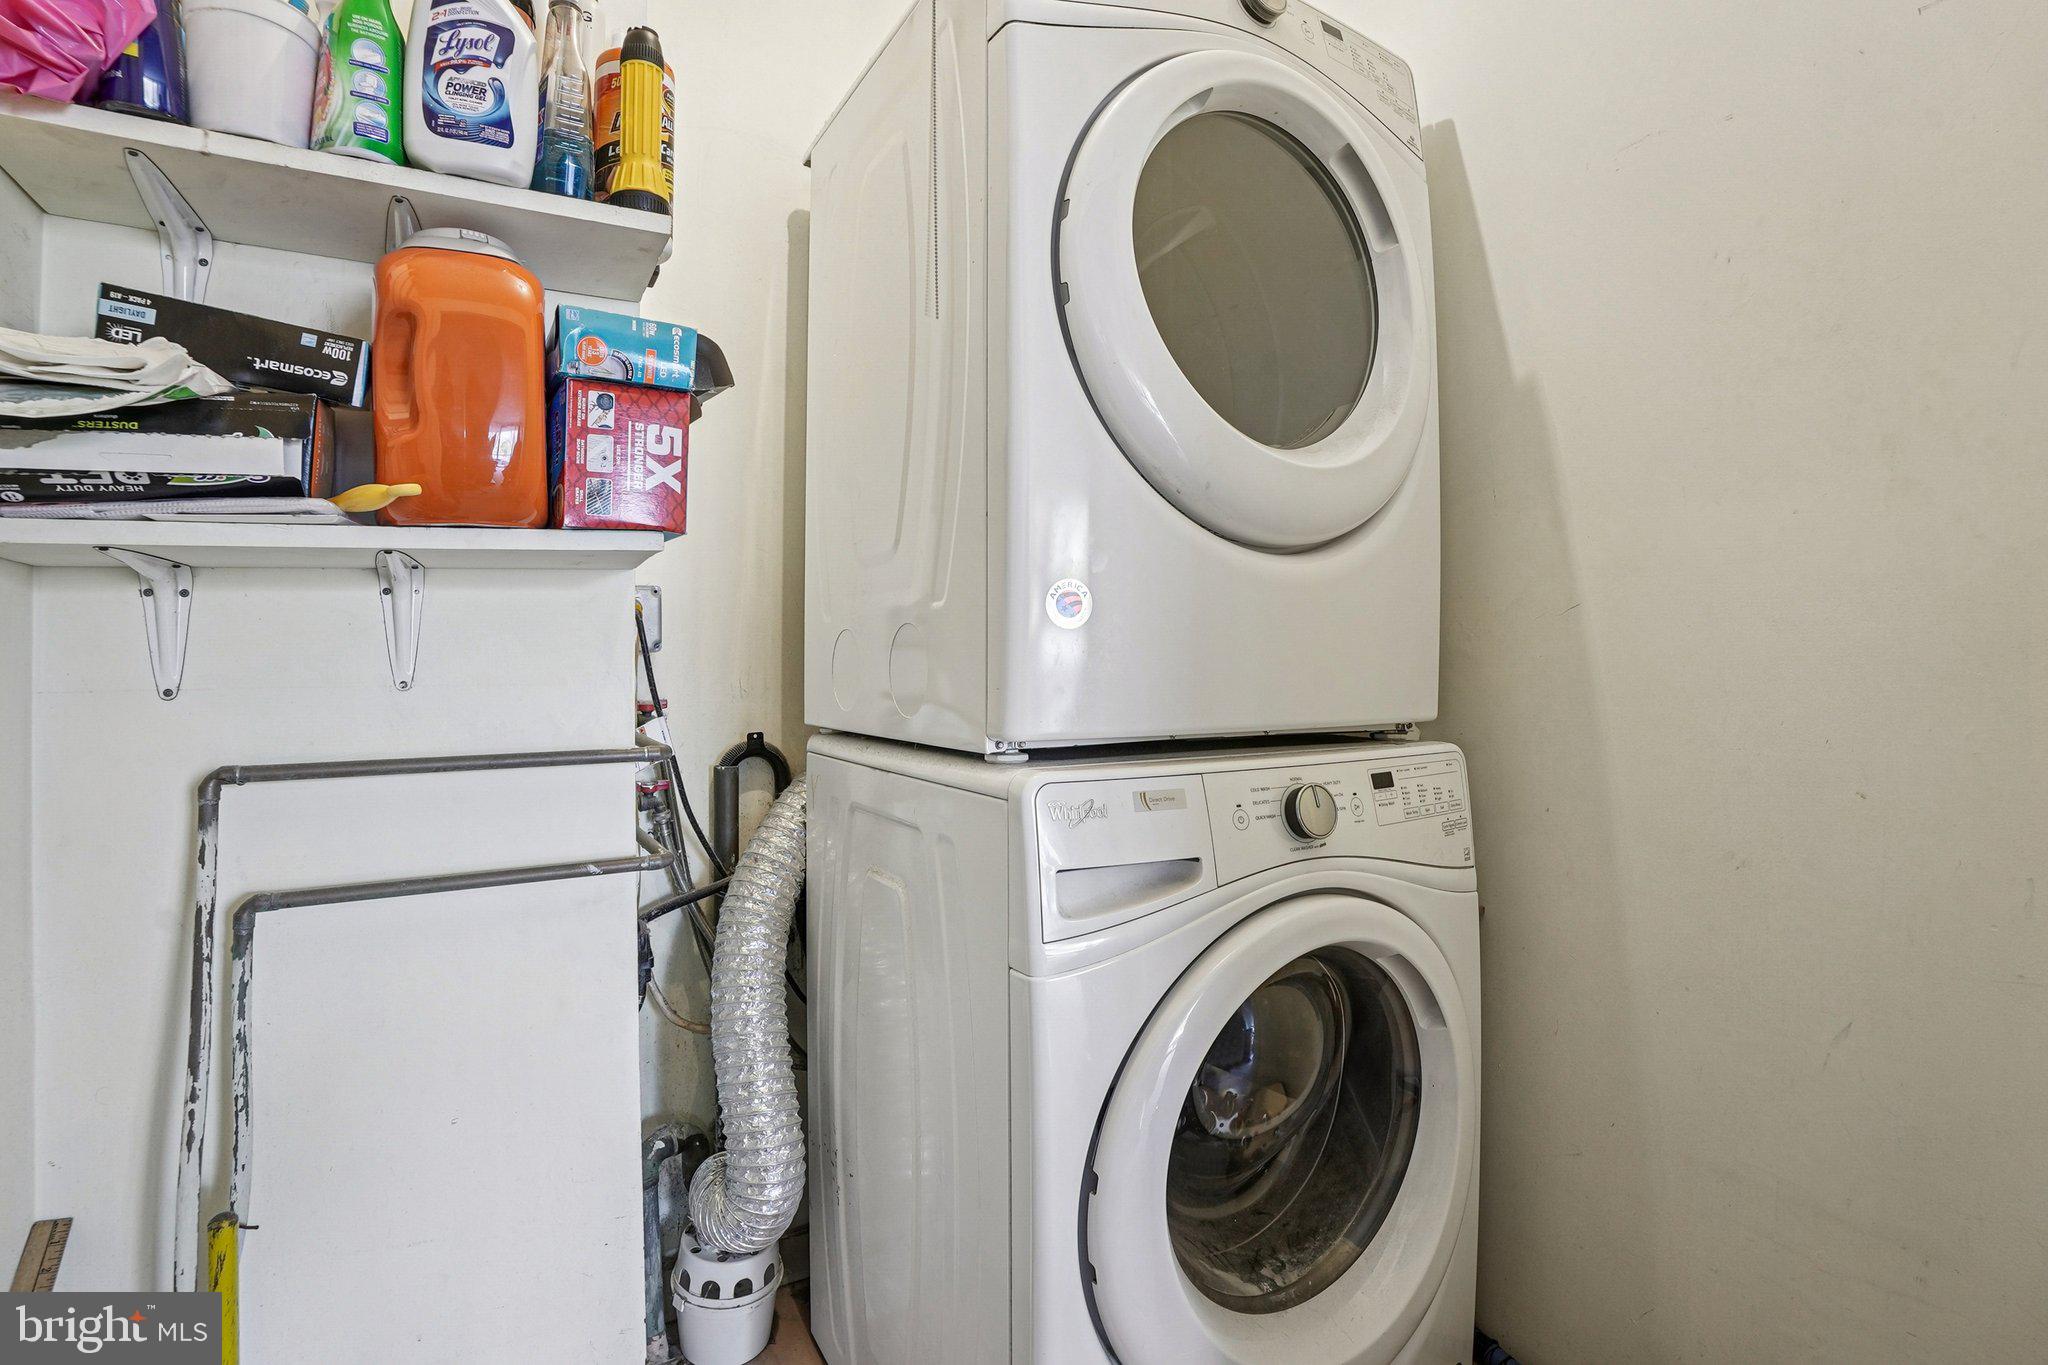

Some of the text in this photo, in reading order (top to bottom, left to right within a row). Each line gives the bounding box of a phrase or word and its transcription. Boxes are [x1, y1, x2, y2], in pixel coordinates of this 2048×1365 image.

[439, 29, 495, 57] Lysol
[445, 82, 487, 97] POWER
[445, 90, 475, 99] CLINGING
[108, 304, 146, 319] DAYLIGHT
[110, 327, 143, 343] LED
[322, 346, 352, 362] 100W
[253, 357, 332, 381] ecosmart
[76, 419, 139, 431] DUSTERS
[634, 421, 645, 491] STRONGER
[645, 423, 683, 495] 5X
[55, 484, 144, 492] HEAVY DUTY
[1050, 582, 1088, 600] AMERICA
[1047, 801, 1108, 829] Whirlpool
